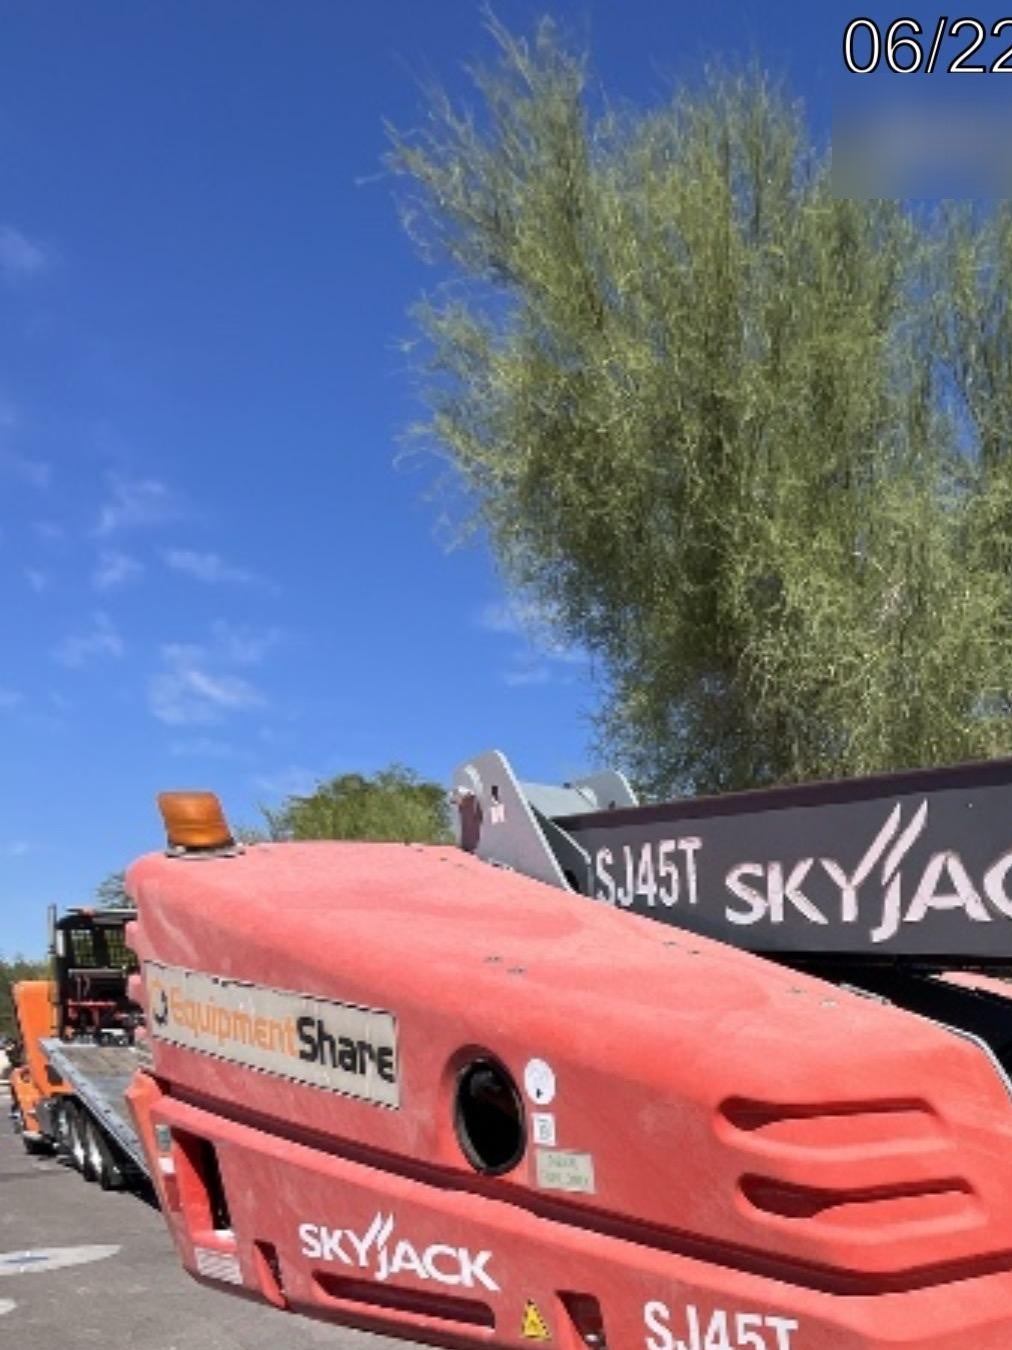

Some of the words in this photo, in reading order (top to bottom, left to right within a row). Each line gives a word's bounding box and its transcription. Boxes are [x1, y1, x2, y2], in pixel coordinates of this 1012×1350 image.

[595, 835, 703, 907] SJ45T
[168, 986, 396, 1084] EquipmentShare
[298, 1211, 500, 1291] SKYJACK
